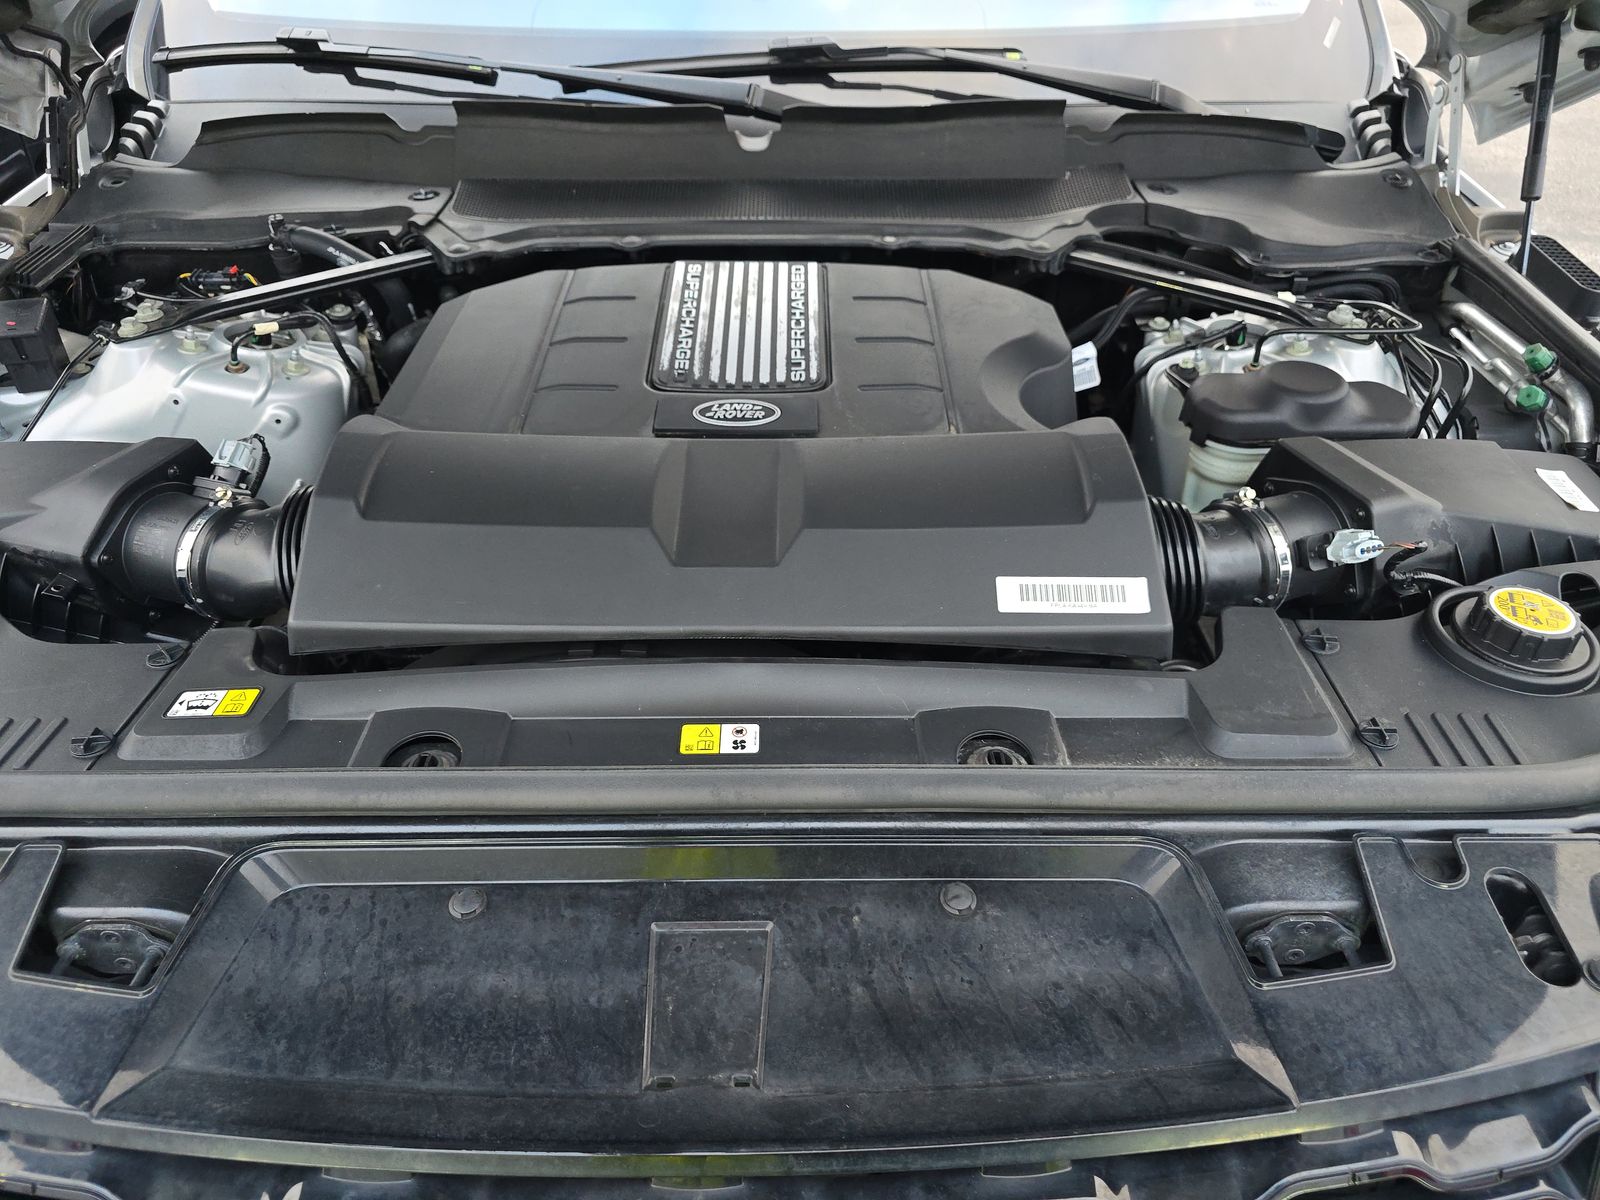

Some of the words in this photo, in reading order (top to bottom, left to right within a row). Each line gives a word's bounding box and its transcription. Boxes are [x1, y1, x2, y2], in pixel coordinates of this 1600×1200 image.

[790, 264, 806, 382] SUPERCHARGED
[711, 403, 754, 411] LAND
[713, 410, 766, 419] ROVER
